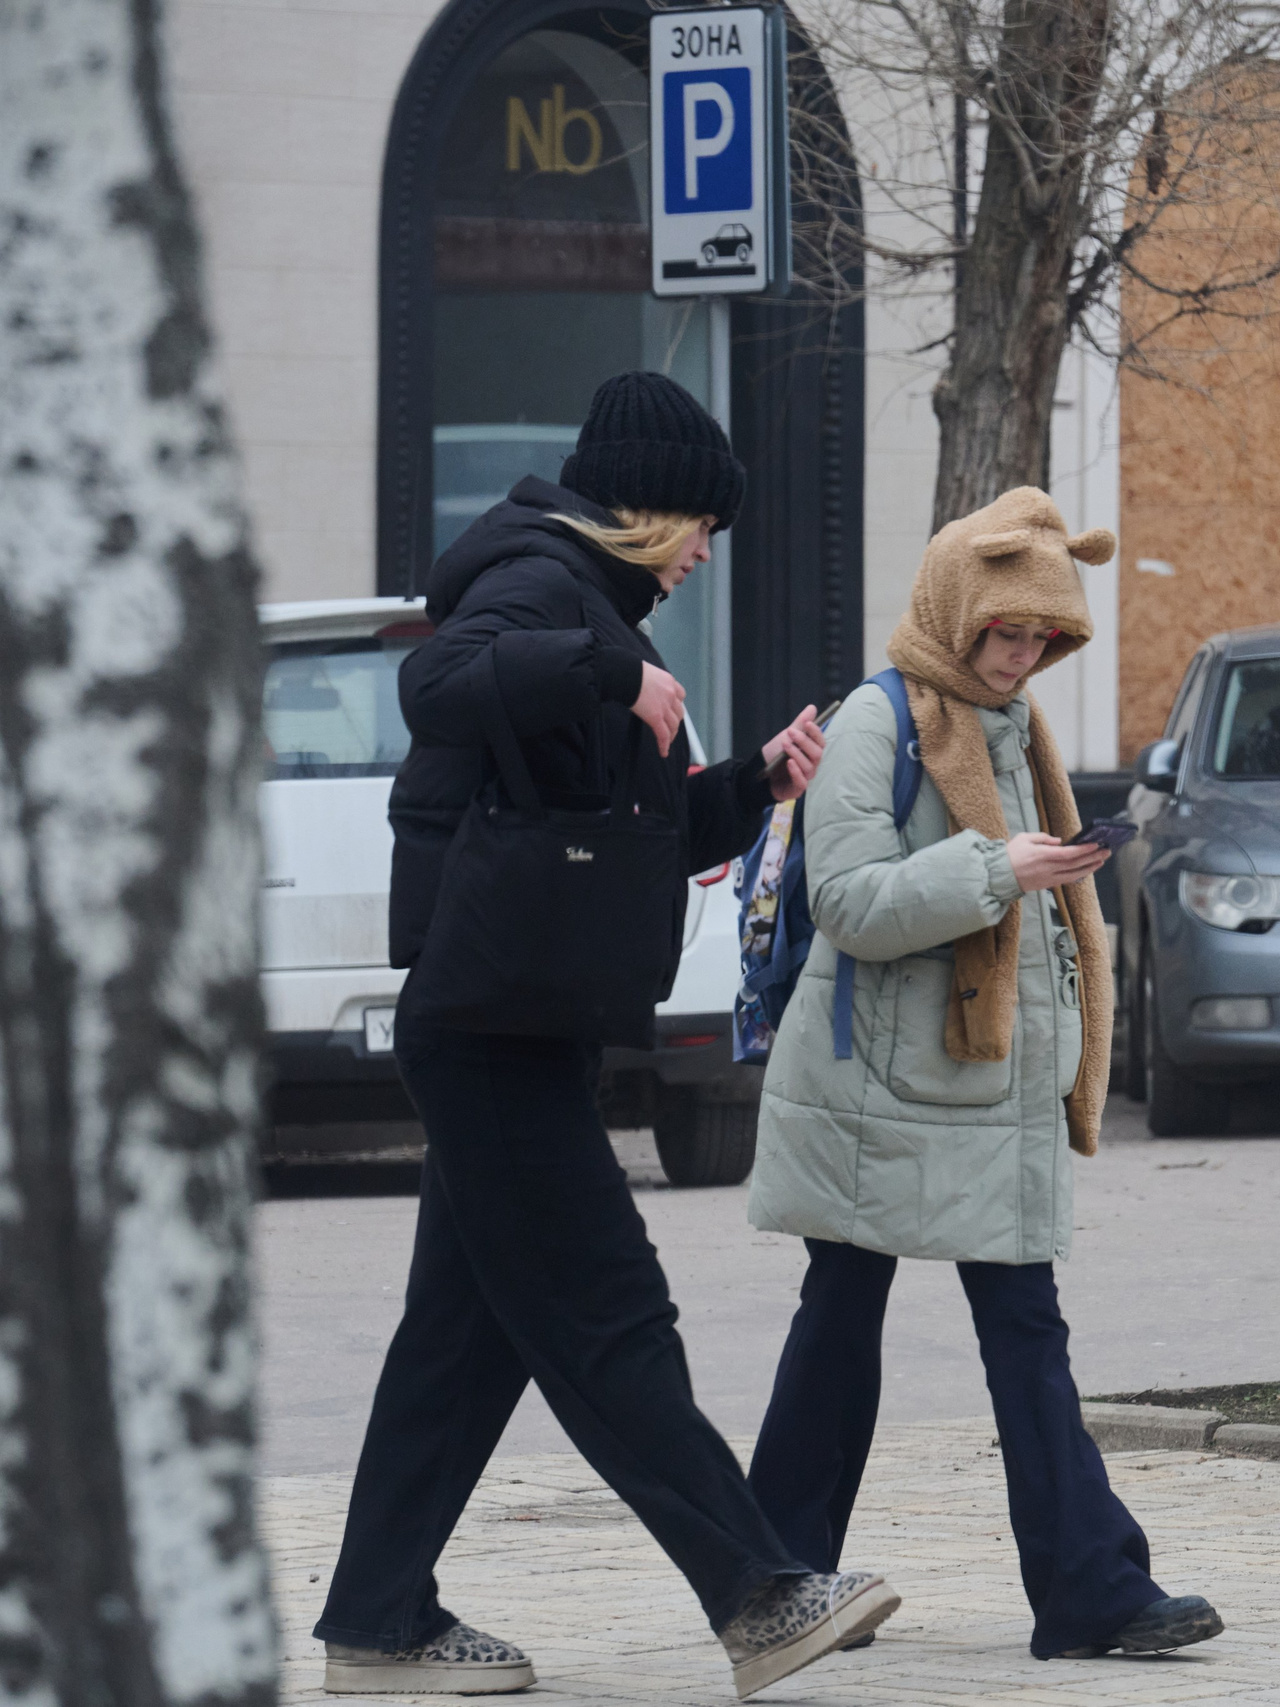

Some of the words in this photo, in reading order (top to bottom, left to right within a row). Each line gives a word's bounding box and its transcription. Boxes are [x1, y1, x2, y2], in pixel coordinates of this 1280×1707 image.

[671, 25, 742, 58] ЗОНА
[507, 84, 602, 175] Nb
[683, 81, 735, 199] P
